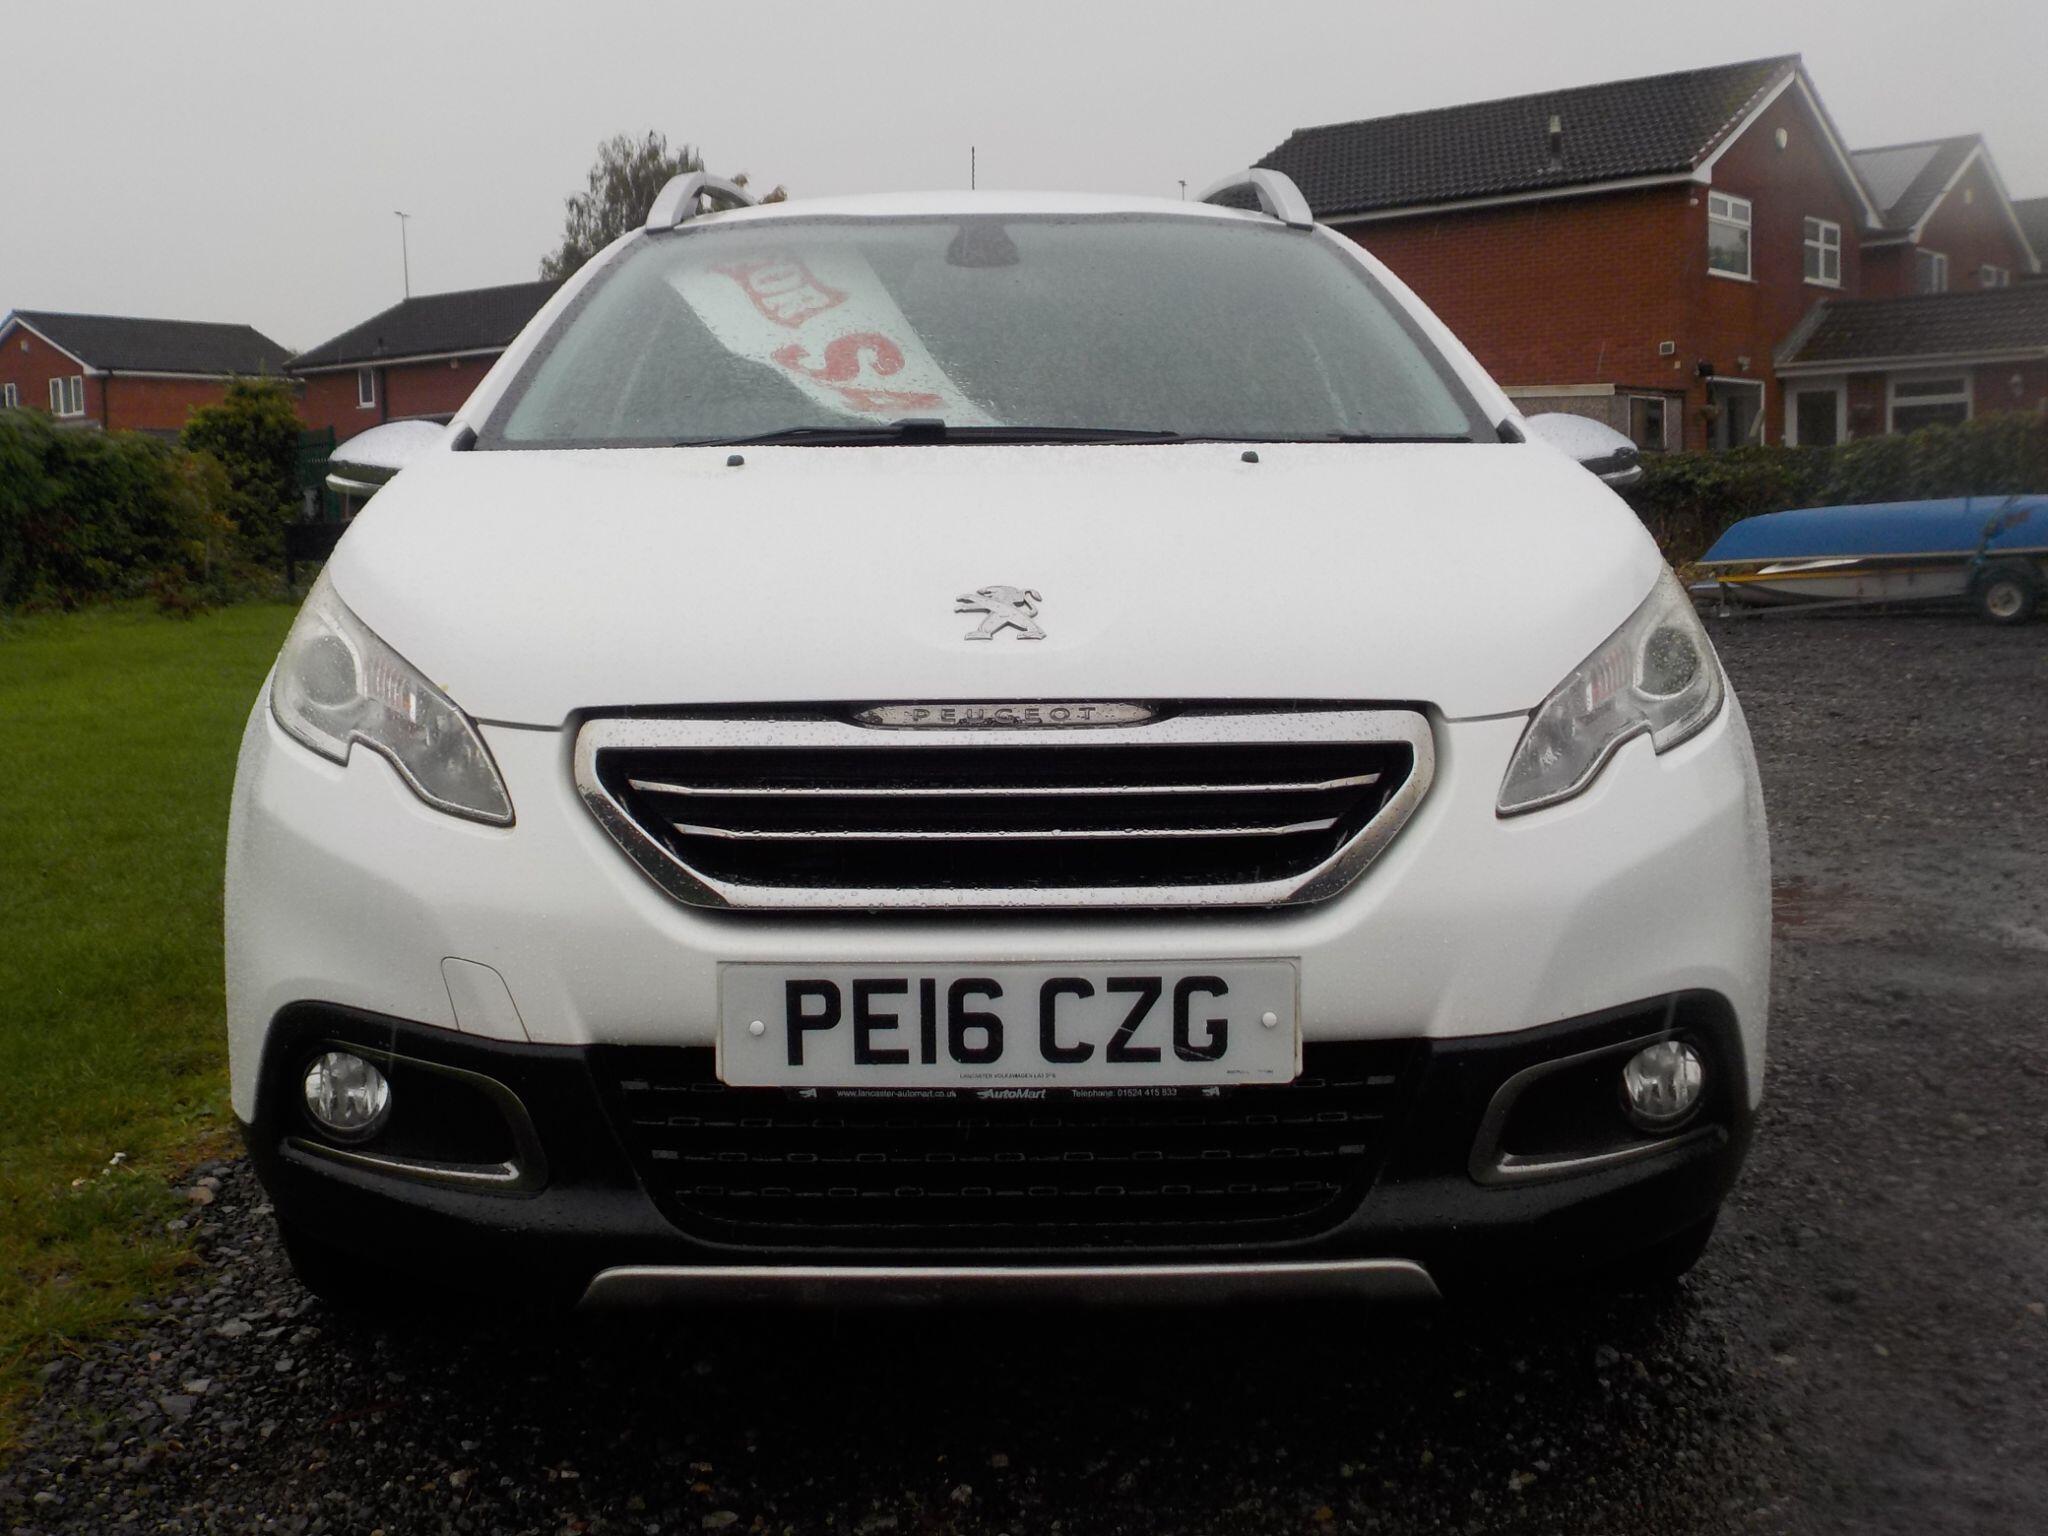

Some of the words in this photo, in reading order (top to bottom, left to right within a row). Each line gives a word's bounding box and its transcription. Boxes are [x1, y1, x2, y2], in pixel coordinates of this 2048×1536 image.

[912, 706, 1096, 724] PEUGEOT
[785, 977, 1004, 1066] PE16
[1039, 975, 1229, 1063] CZG
[837, 1088, 957, 1098] www.lancaster-automart.co.uk
[978, 1088, 1046, 1099] AutoMart
